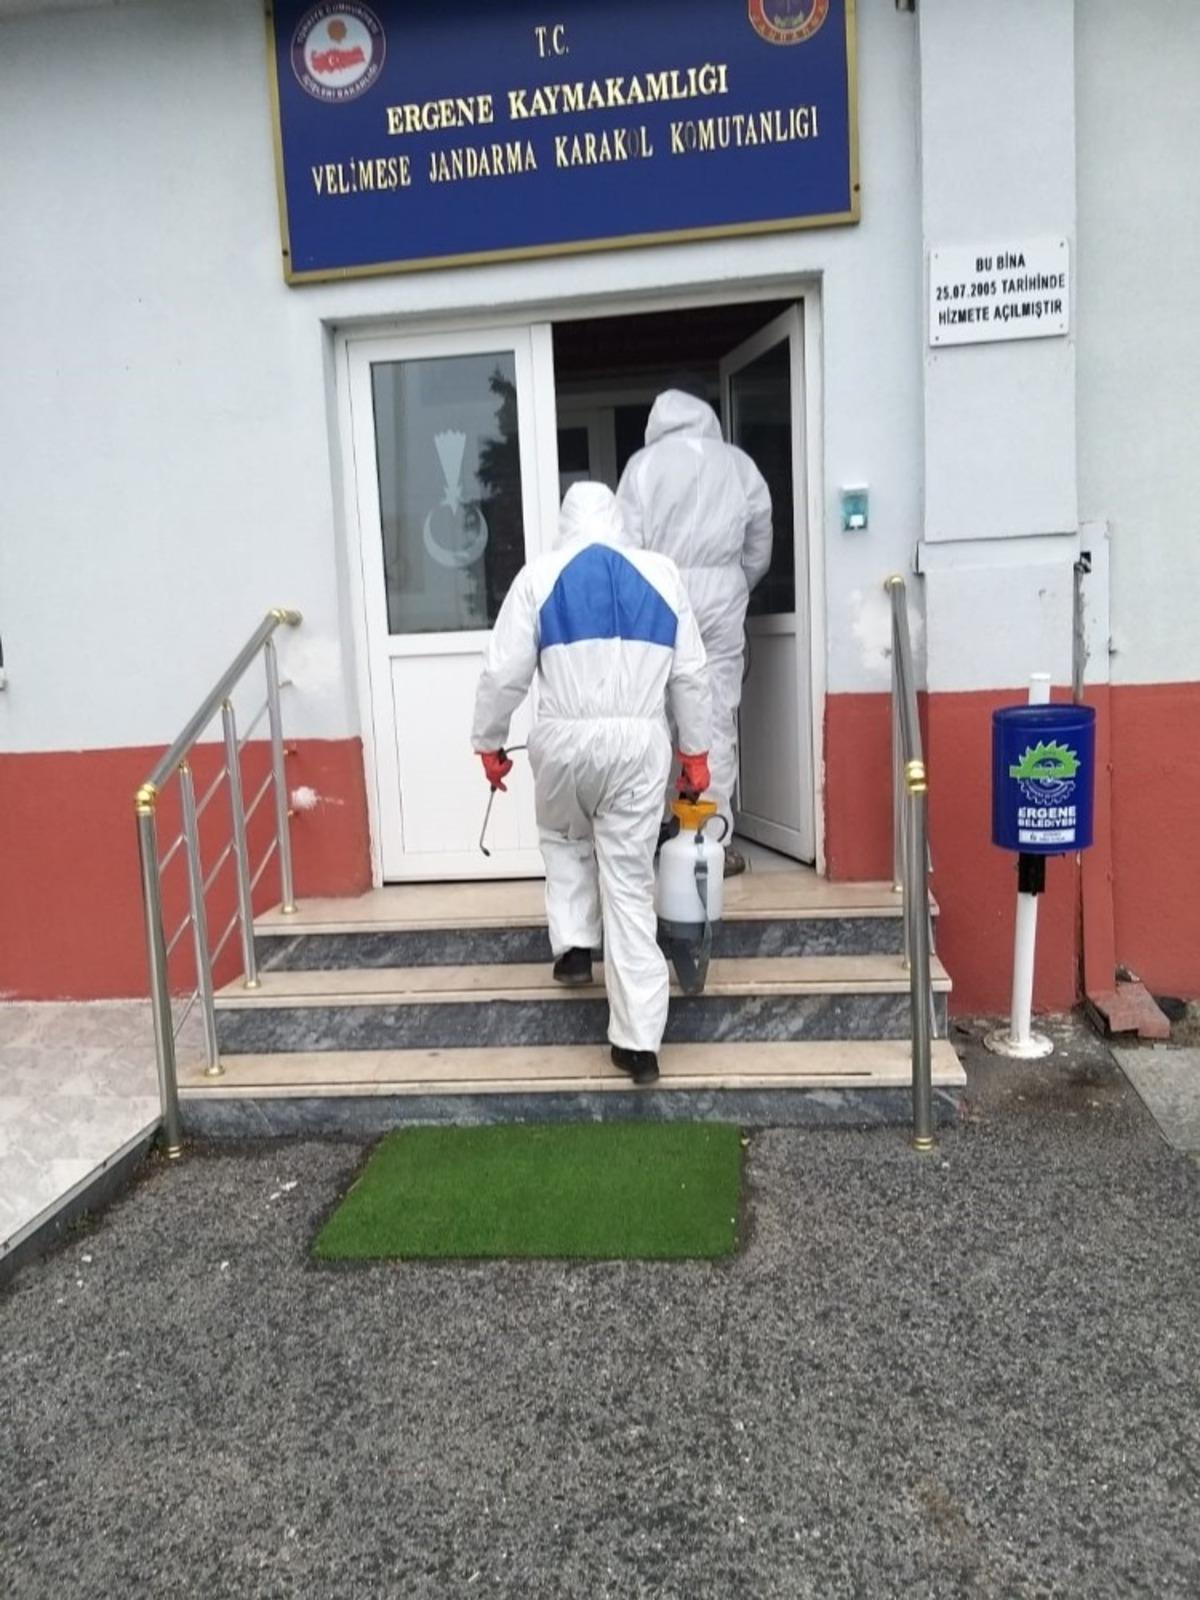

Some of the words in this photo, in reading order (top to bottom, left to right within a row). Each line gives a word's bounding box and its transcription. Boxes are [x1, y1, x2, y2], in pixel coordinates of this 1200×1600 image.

[386, 94, 494, 135] ERGENE
[507, 63, 728, 120] KAYMAKAMLIĞI
[311, 155, 411, 195] VELİMEŞE
[429, 140, 537, 183] JANDARMA
[555, 125, 653, 168] KARAKOL
[670, 105, 818, 154] KOMUTANLIĞI
[976, 256, 993, 273] BU
[996, 251, 1026, 271] BİNA
[936, 280, 997, 301] 25.07.2005
[1002, 272, 1065, 294] TARİHİNDE
[938, 306, 990, 325] HİZMETE
[993, 298, 1063, 322] AÇILMIŞTIR
[1018, 805, 1076, 818] ERGENE
